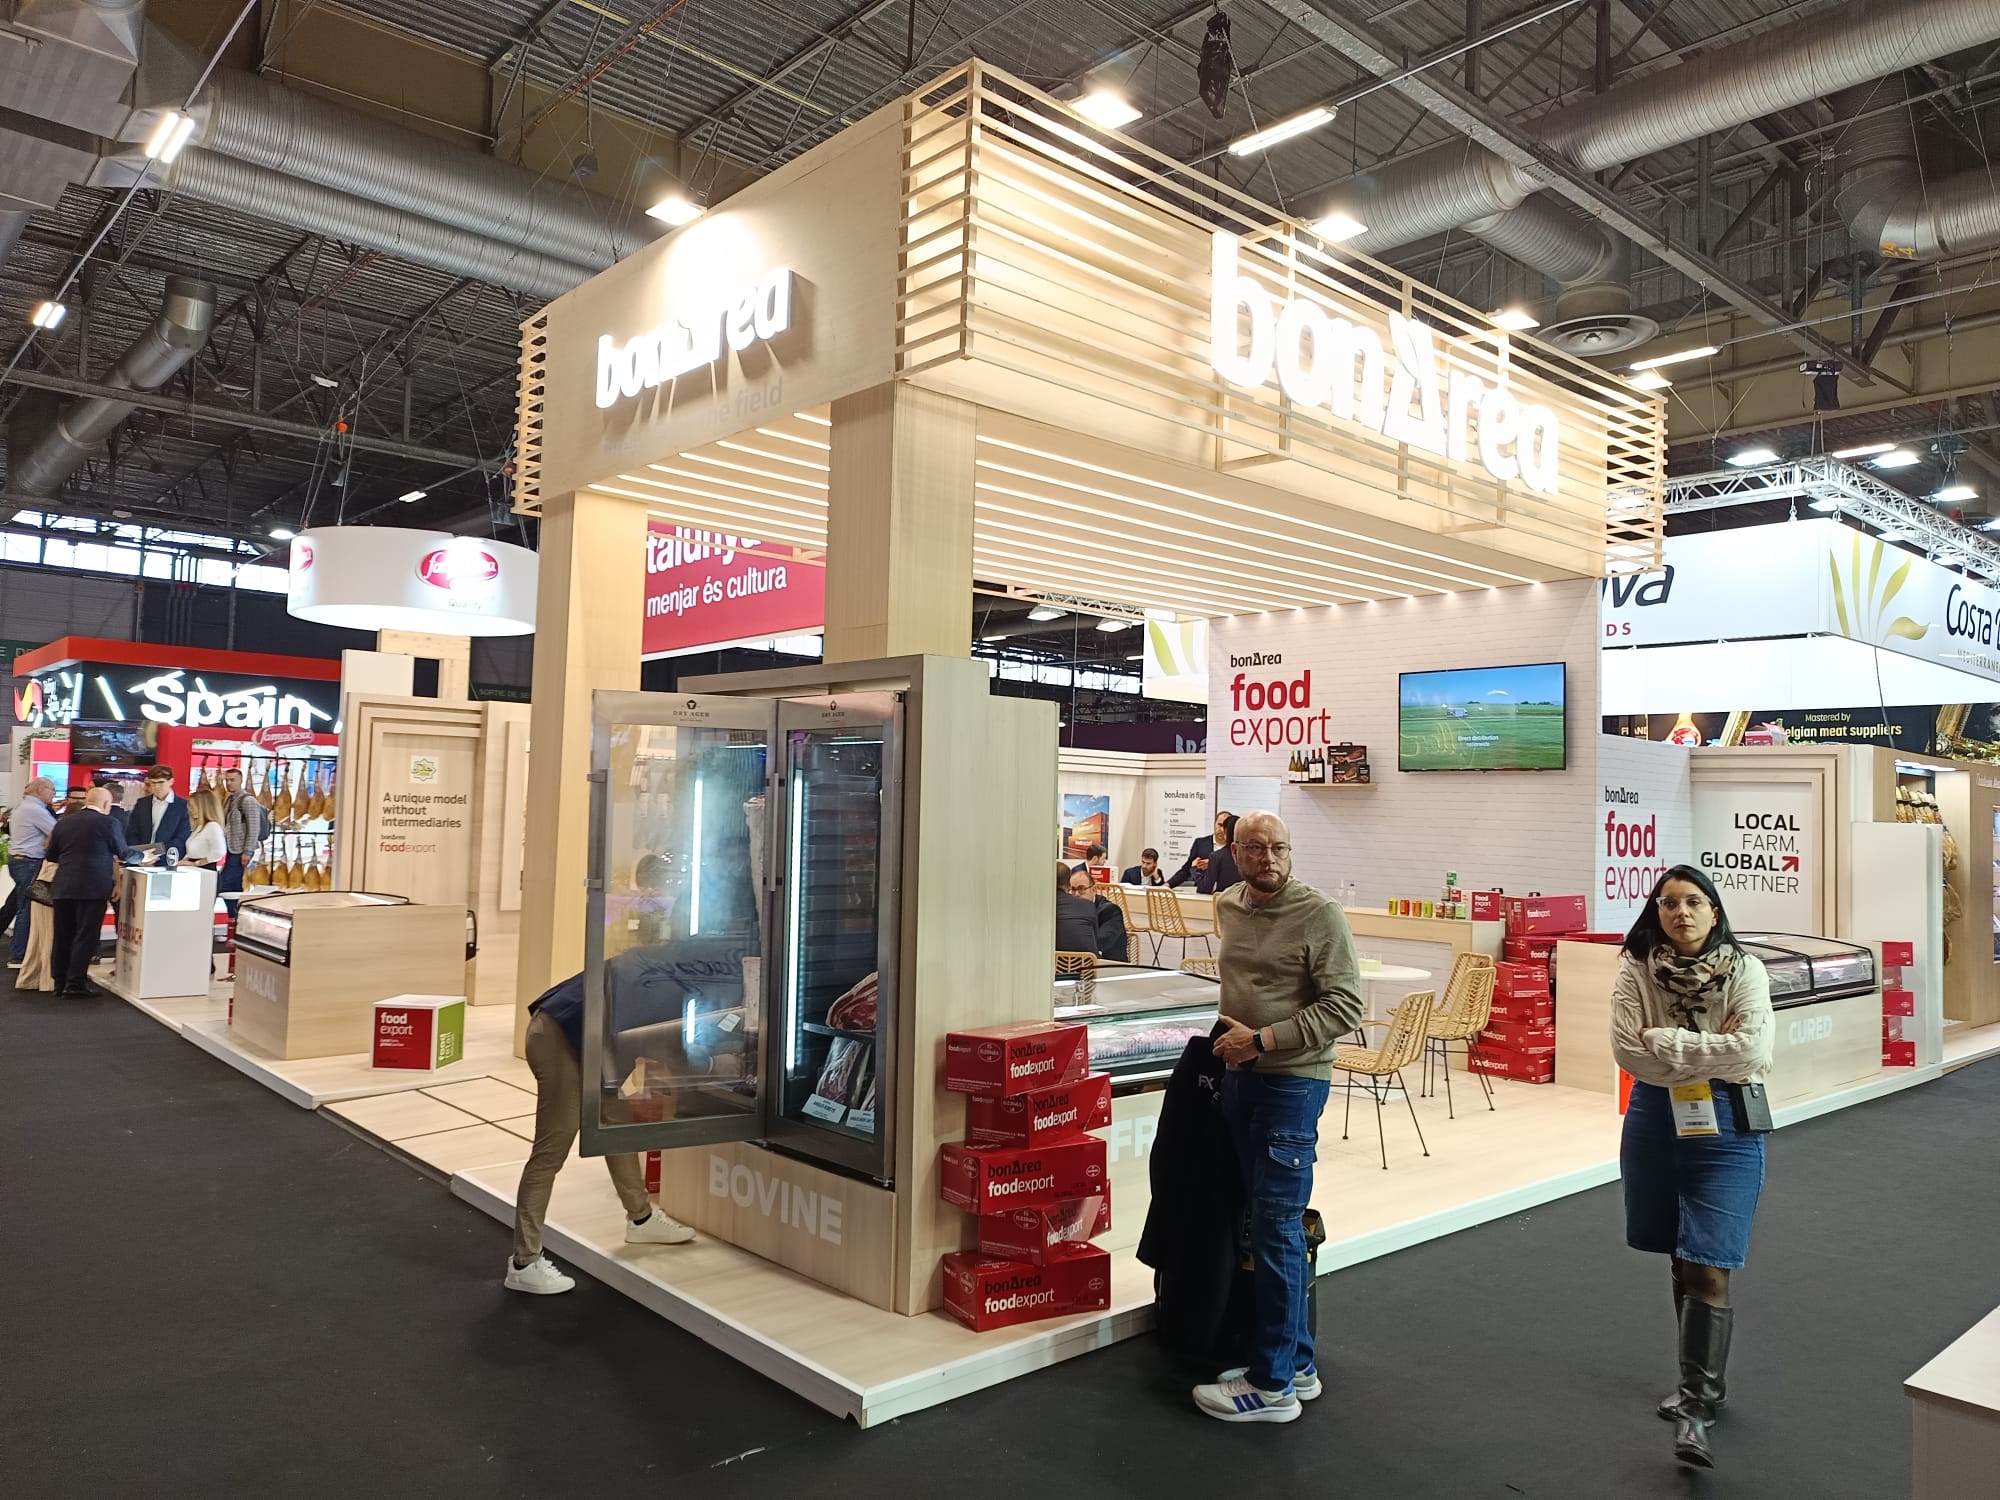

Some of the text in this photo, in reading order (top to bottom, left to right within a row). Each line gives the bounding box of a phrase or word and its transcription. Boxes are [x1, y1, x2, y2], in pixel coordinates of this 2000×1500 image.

[647, 566, 787, 618] menjar és cultura
[1230, 670, 1311, 711] food
[140, 676, 314, 729] Spain
[1805, 712, 1851, 722] Mastered by
[1230, 707, 1332, 753] export
[1786, 723, 1902, 740] elgian meat suppliers
[382, 804, 427, 815] without
[383, 792, 467, 804] A unique model
[382, 816, 462, 828] intermediaries
[1735, 813, 1800, 832] LOCAL
[1605, 810, 1655, 858] food
[1742, 834, 1800, 855] FARM,
[379, 842, 437, 853] foodexport
[1700, 852, 1780, 872] GLOBAL
[1712, 872, 1800, 895] PARTNER
[381, 1012, 407, 1025] food
[1788, 1015, 1833, 1045] CURED
[380, 1025, 413, 1036] export
[1010, 1056, 1055, 1079] foodexport
[1033, 1107, 1078, 1132] foodexport
[987, 1174, 1055, 1198] foodexport
[709, 1155, 843, 1246] BOVINE
[984, 1288, 1055, 1314] foodexport
